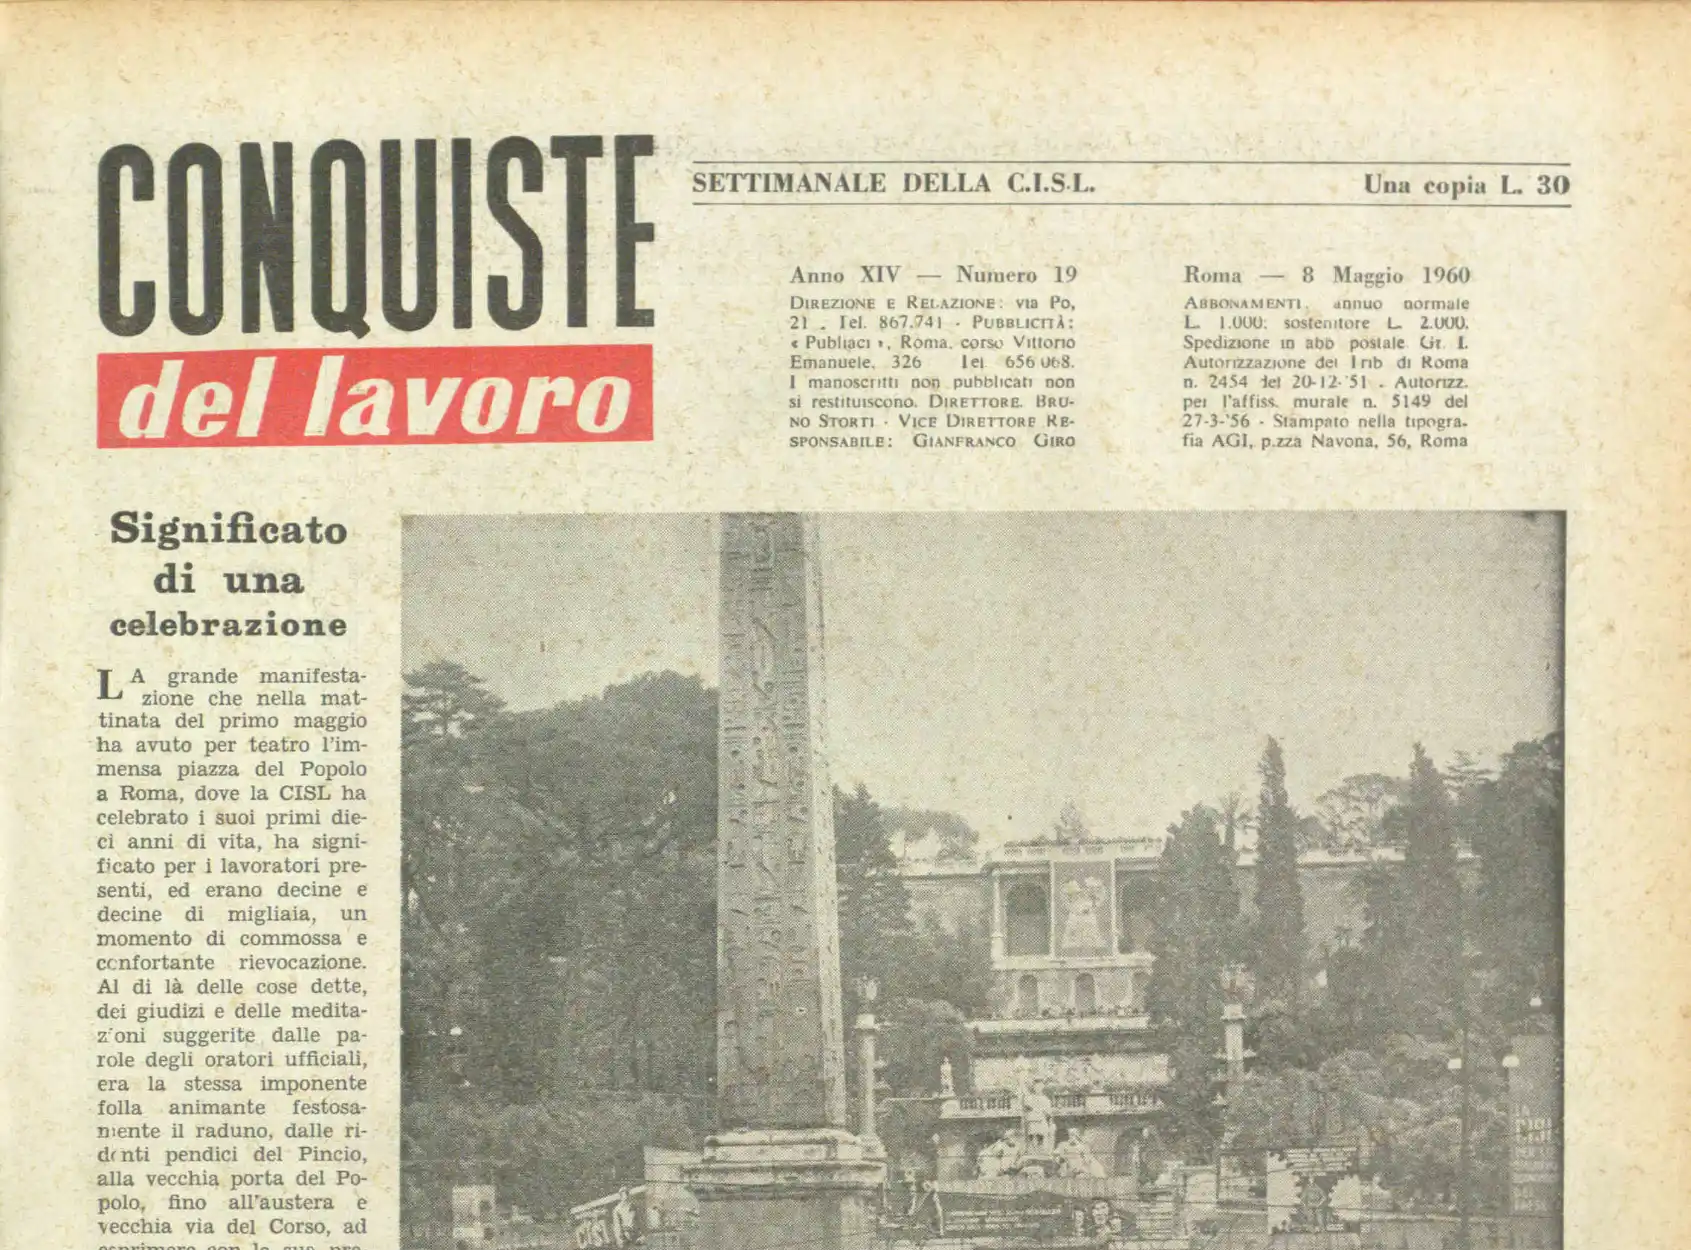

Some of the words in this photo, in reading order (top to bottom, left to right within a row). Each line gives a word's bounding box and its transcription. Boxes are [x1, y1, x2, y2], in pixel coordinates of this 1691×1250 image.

[692, 171, 887, 193] SETTIMANALE
[903, 171, 992, 193] DELLA
[1364, 172, 1411, 194] Una
[1423, 174, 1487, 201] copia
[1500, 174, 1524, 195] L.
[1536, 174, 1571, 196] 30
[98, 134, 655, 339] CONQUISTE
[790, 265, 845, 284] Anno
[860, 264, 901, 283] XIV
[956, 264, 1038, 284] Numero
[1054, 265, 1078, 284] 19
[1184, 264, 1242, 284] Roma
[1302, 265, 1315, 284] 8
[1333, 265, 1404, 289] Maggio
[1423, 266, 1471, 284] 1960
[790, 295, 876, 310] DIREZIONE
[886, 298, 896, 310] E
[1015, 298, 1039, 310] via
[1333, 299, 1383, 311] annuo
[1403, 298, 1470, 311] normale
[789, 315, 808, 330] 21
[1283, 317, 1370, 330] sostenitore
[960, 338, 1004, 350] corso
[1013, 334, 1076, 350] Vittorio
[1183, 334, 1270, 353] Spedizione
[1457, 335, 1469, 351] I.
[891, 354, 922, 369] 326
[1183, 355, 1307, 370] Autorizzazione
[1396, 355, 1412, 370] di
[1421, 355, 1469, 370] Roma
[789, 374, 796, 390] I
[808, 376, 899, 389] manoscritti
[911, 377, 941, 390] non
[953, 375, 1033, 391] pubblicati
[1045, 377, 1076, 389] non
[1208, 373, 1248, 389] 2454
[118, 356, 277, 439] del
[303, 355, 633, 438] lavoro
[788, 397, 802, 409] si
[811, 396, 918, 409] restituiscono.
[1035, 394, 1075, 409] BRU-
[1182, 397, 1207, 412] per
[1293, 395, 1349, 409] murale
[1391, 393, 1432, 409] 5149
[1444, 394, 1469, 409] del
[789, 416, 811, 429] NO
[818, 413, 875, 429] STORTI
[898, 413, 938, 429] VICE
[946, 413, 1036, 428] DIRETTORE
[1046, 413, 1075, 428] RE-
[1273, 413, 1349, 432] Stampato
[1358, 413, 1396, 429] nella
[1405, 415, 1468, 432] tipogra-
[789, 435, 893, 449] SPONSABILE:
[912, 432, 1017, 449] GIANFRANCO
[1033, 432, 1076, 448] GIRO
[1182, 432, 1204, 448] fia
[1420, 433, 1468, 448] Roma
[110, 510, 348, 551] Significato
[153, 561, 197, 594] di
[222, 572, 306, 595] una
[109, 609, 348, 637] celebrazione
[167, 667, 239, 689] grande
[259, 666, 367, 684] manifesta-
[141, 689, 194, 707] zione
[208, 690, 243, 707] che
[256, 689, 307, 707] nella
[320, 689, 368, 707] mat-
[98, 711, 161, 729] tinata
[174, 711, 205, 729] del
[219, 712, 279, 733] primo
[293, 712, 368, 733] maggio
[96, 1170, 135, 1187] alla
[146, 1169, 220, 1187] vecchia
[230, 1170, 285, 1191] porta
[295, 1169, 326, 1186] del
[336, 1170, 368, 1187] Po-
